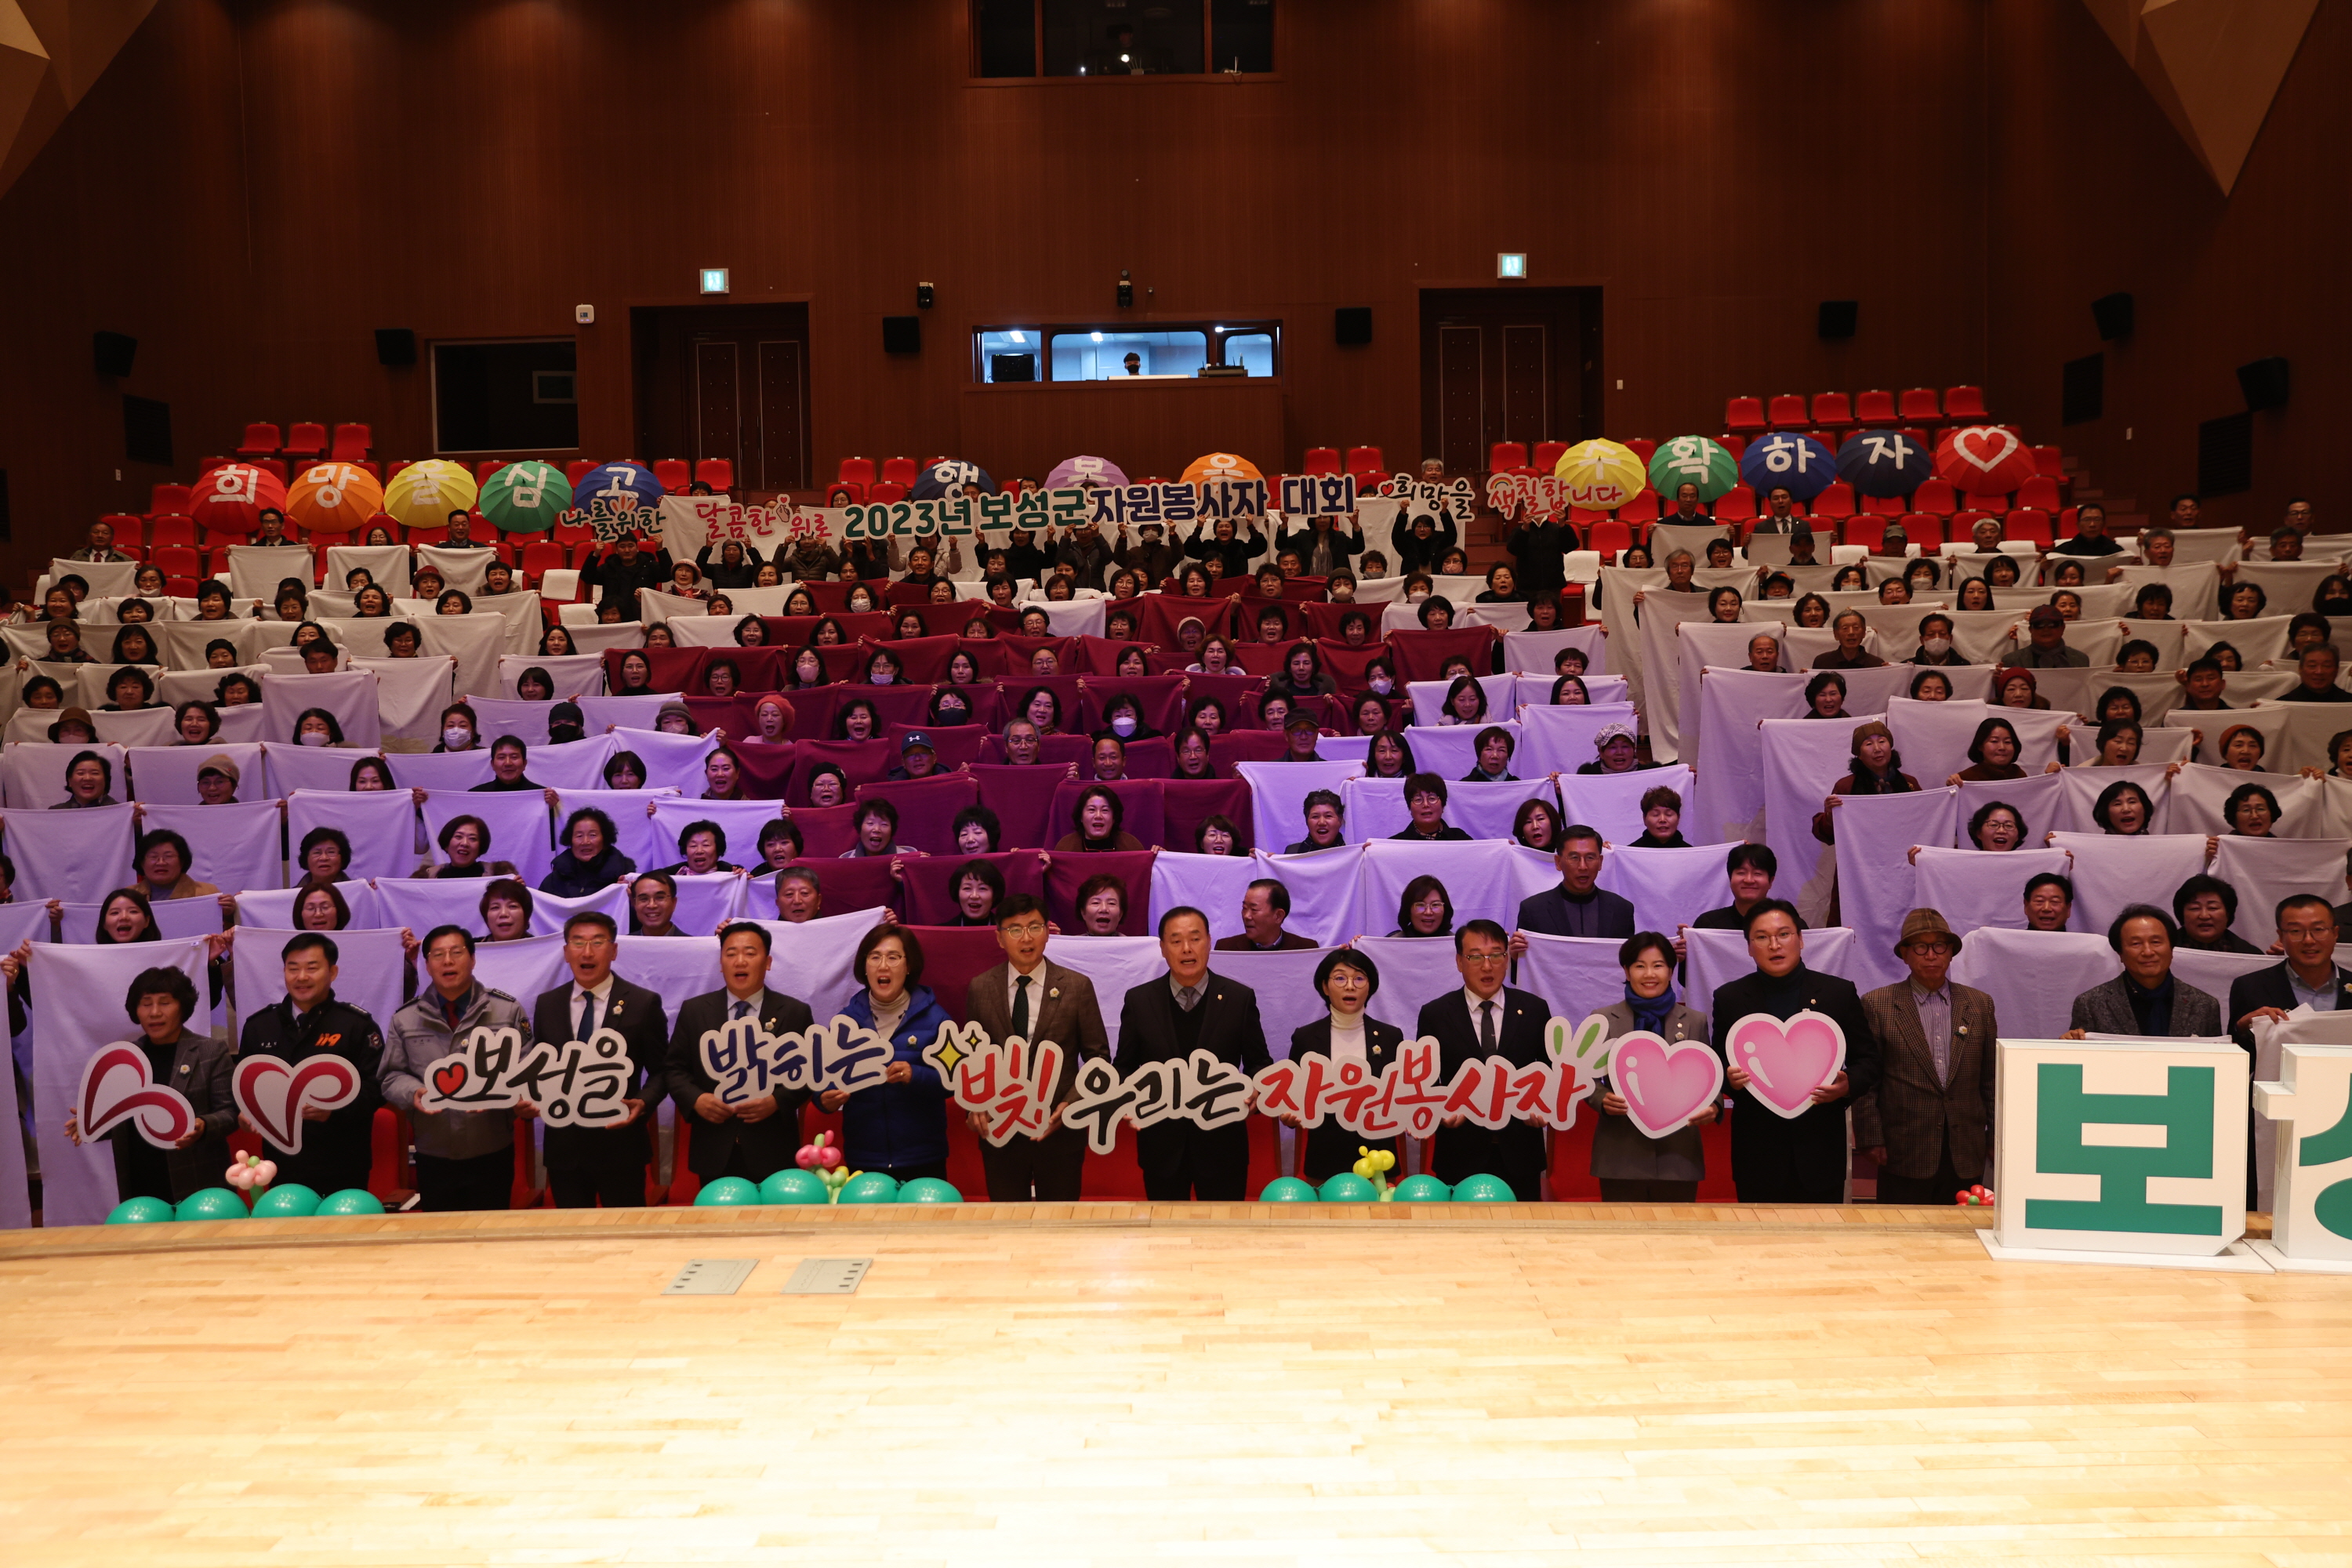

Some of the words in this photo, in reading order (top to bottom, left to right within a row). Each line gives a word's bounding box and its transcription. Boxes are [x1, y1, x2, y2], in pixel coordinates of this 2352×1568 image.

[695, 503, 776, 539] 달콤한
[789, 514, 833, 539] 위로
[844, 498, 972, 538] 2023년
[979, 488, 1087, 531] 보성군
[1090, 479, 1269, 524] 자원봉사자
[1283, 475, 1355, 514] 대회
[1390, 475, 1473, 519] 희망을
[1490, 477, 1623, 517] 색칠합니다
[314, 1033, 342, 1047] 119
[441, 1035, 626, 1118] 보성을
[707, 1021, 887, 1105] 밝히는
[961, 1044, 1055, 1139] 빛!
[1069, 1056, 1247, 1147] 우리는
[1260, 1044, 1587, 1131] 자원봉사자
